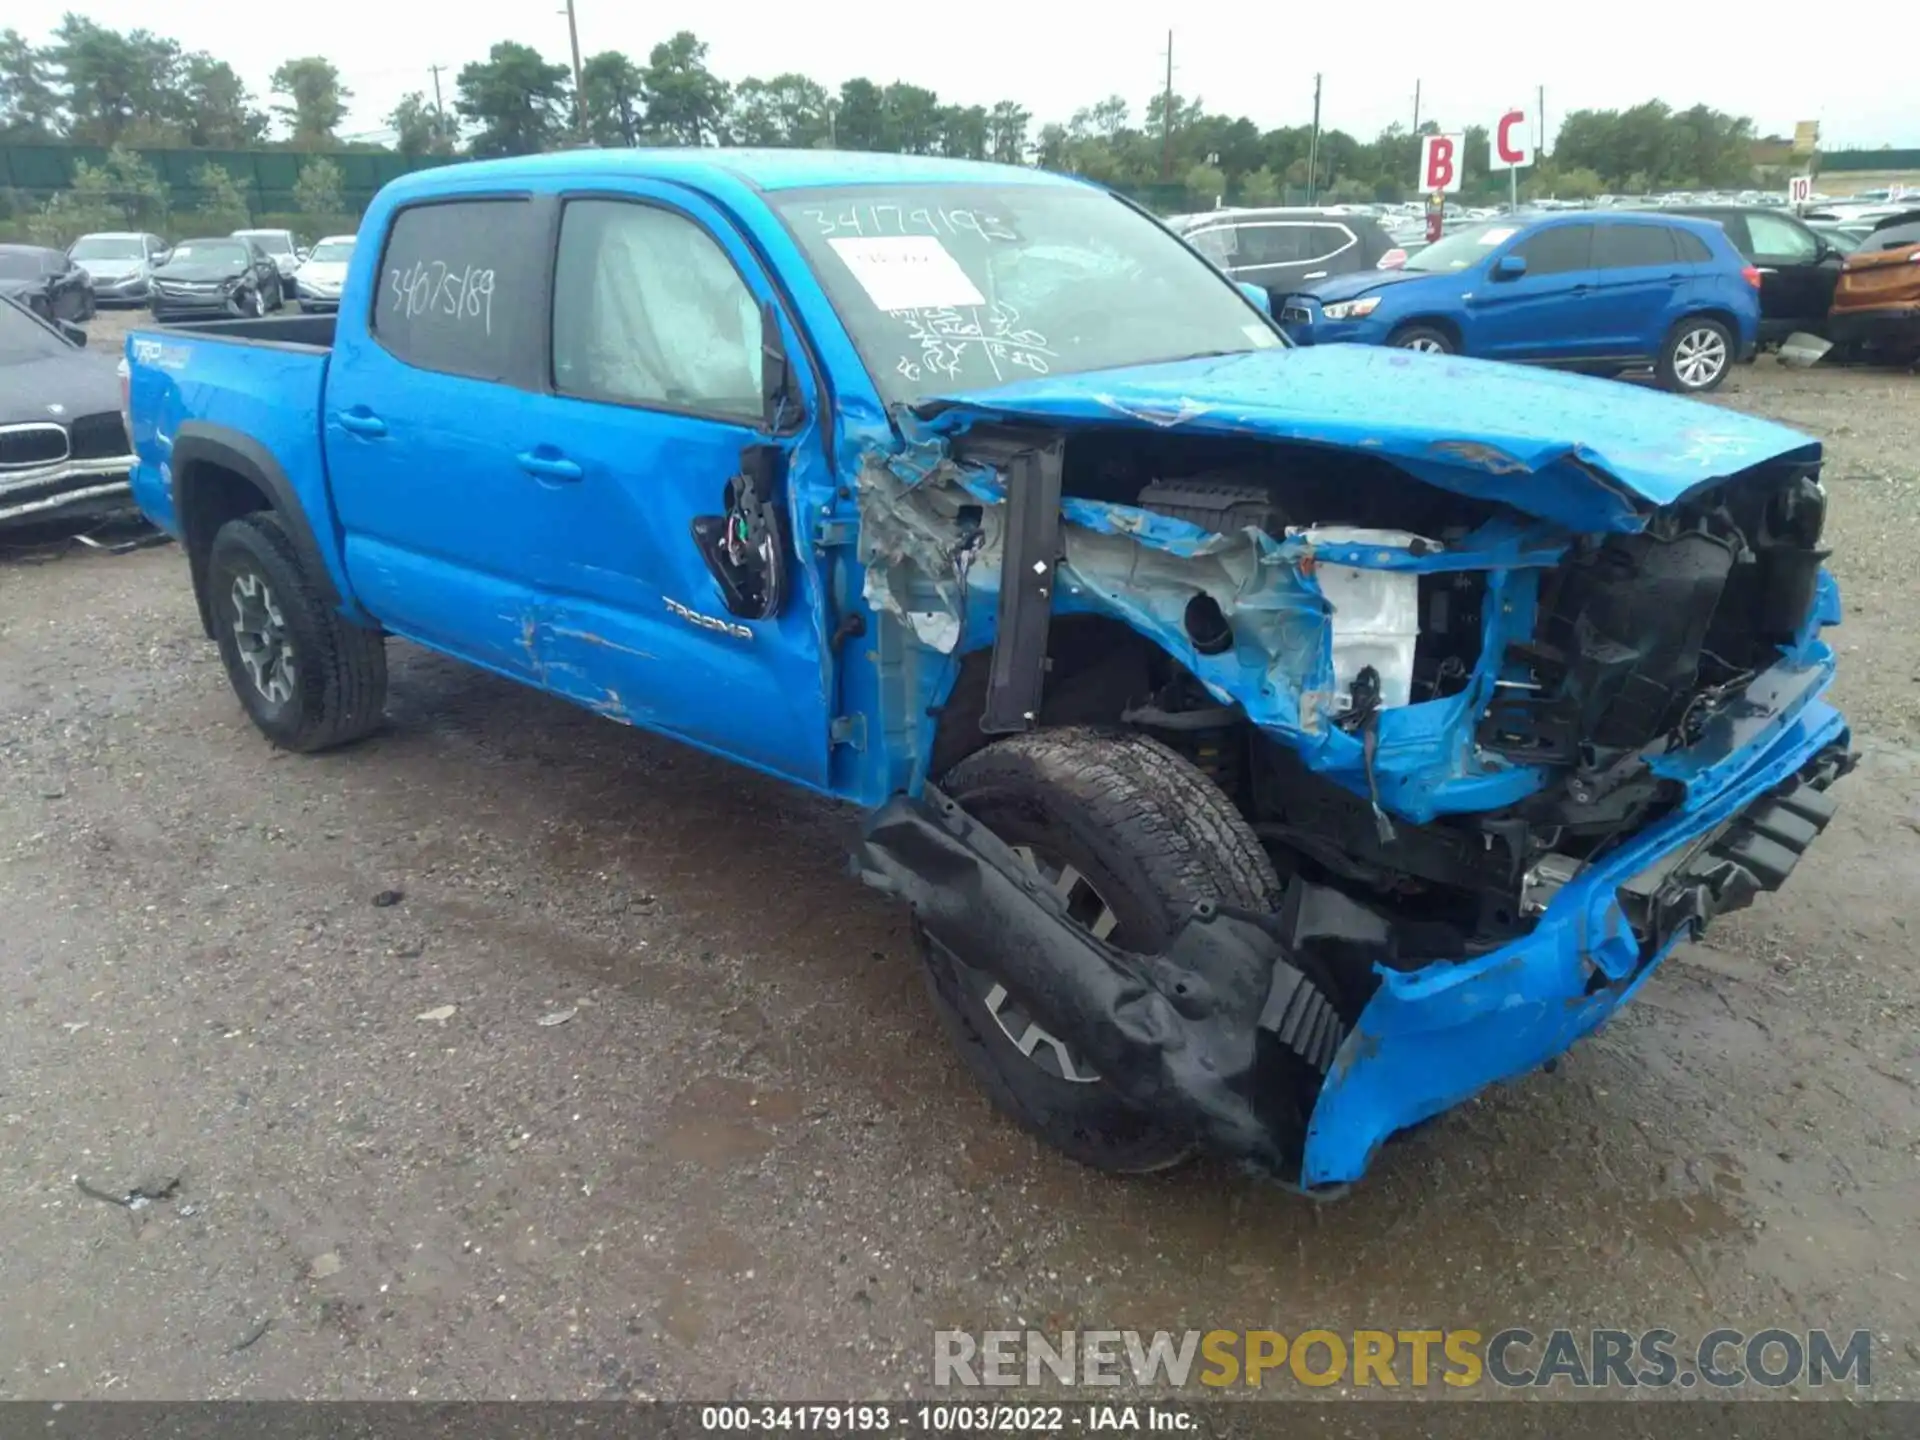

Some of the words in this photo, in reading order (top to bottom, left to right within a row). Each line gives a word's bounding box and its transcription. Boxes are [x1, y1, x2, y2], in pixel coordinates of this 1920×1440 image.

[1498, 111, 1524, 163] C
[1427, 138, 1453, 187] B
[1793, 179, 1808, 201] 10
